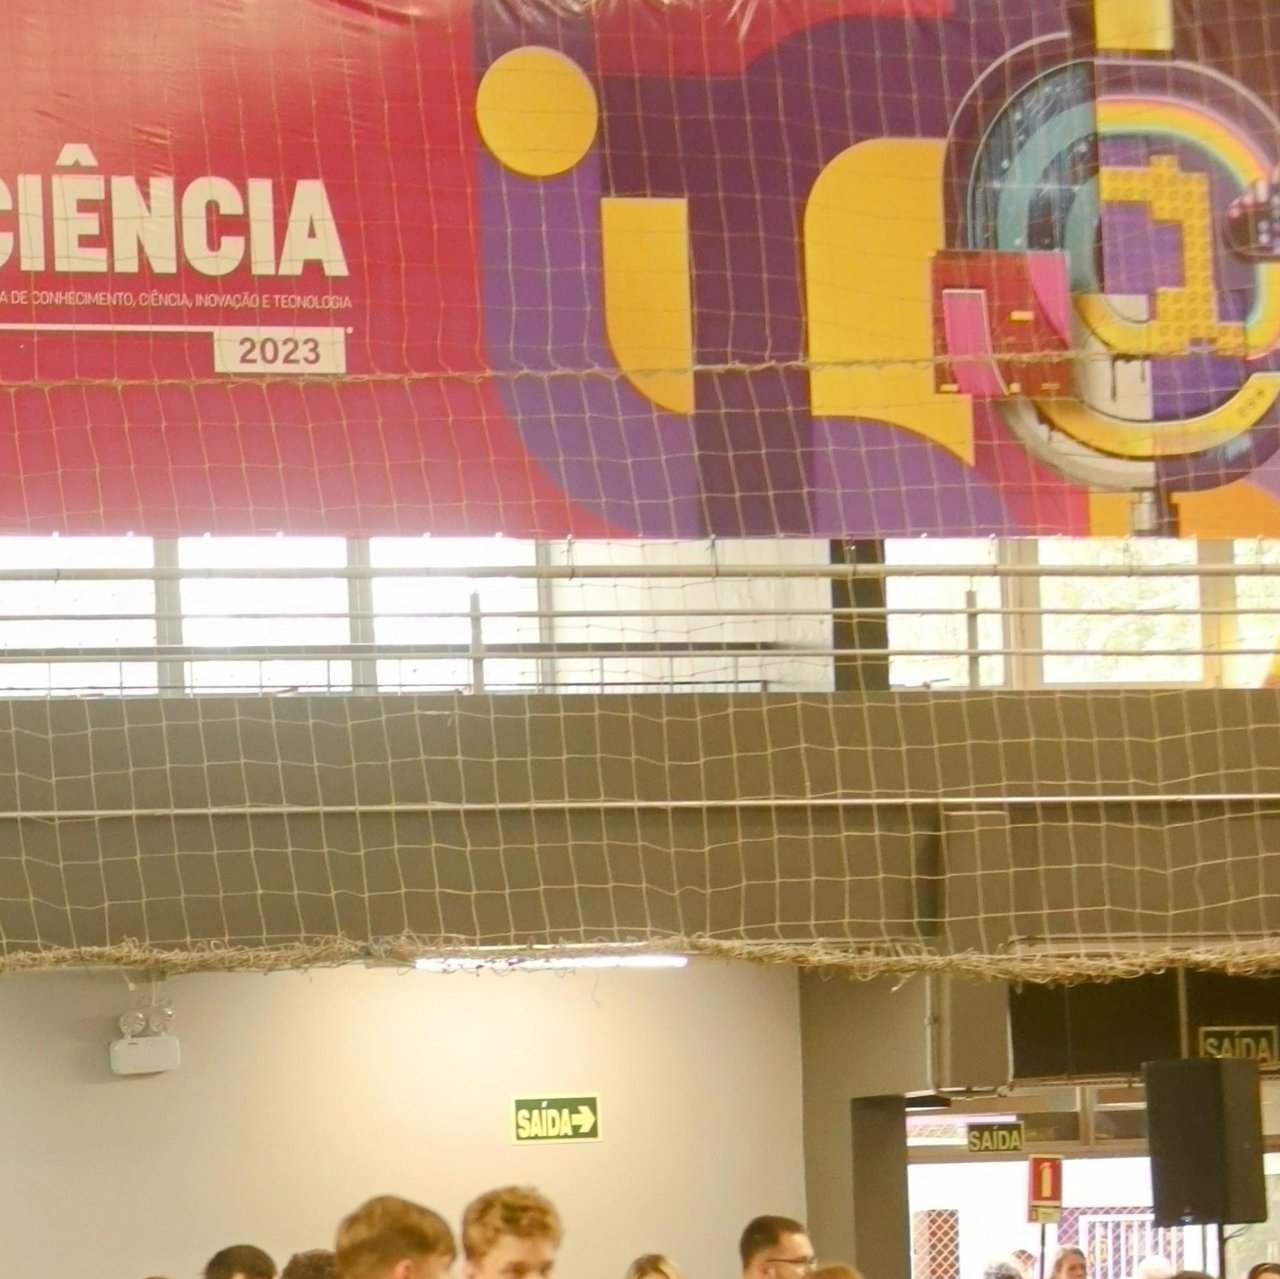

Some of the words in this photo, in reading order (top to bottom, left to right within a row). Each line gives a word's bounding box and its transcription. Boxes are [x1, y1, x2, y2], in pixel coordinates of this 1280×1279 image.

[11, 291, 28, 304] DE
[32, 291, 136, 307] CONHECIMENTO,
[138, 288, 192, 308] CIÊNCIA,
[195, 291, 259, 309] INOVAÇÃO
[263, 295, 269, 307] E
[273, 294, 352, 309] TECNOLOGIA
[239, 337, 321, 364] 2023
[517, 1101, 573, 1138] SAÍDA
[970, 1125, 1021, 1151] SAÍDA
